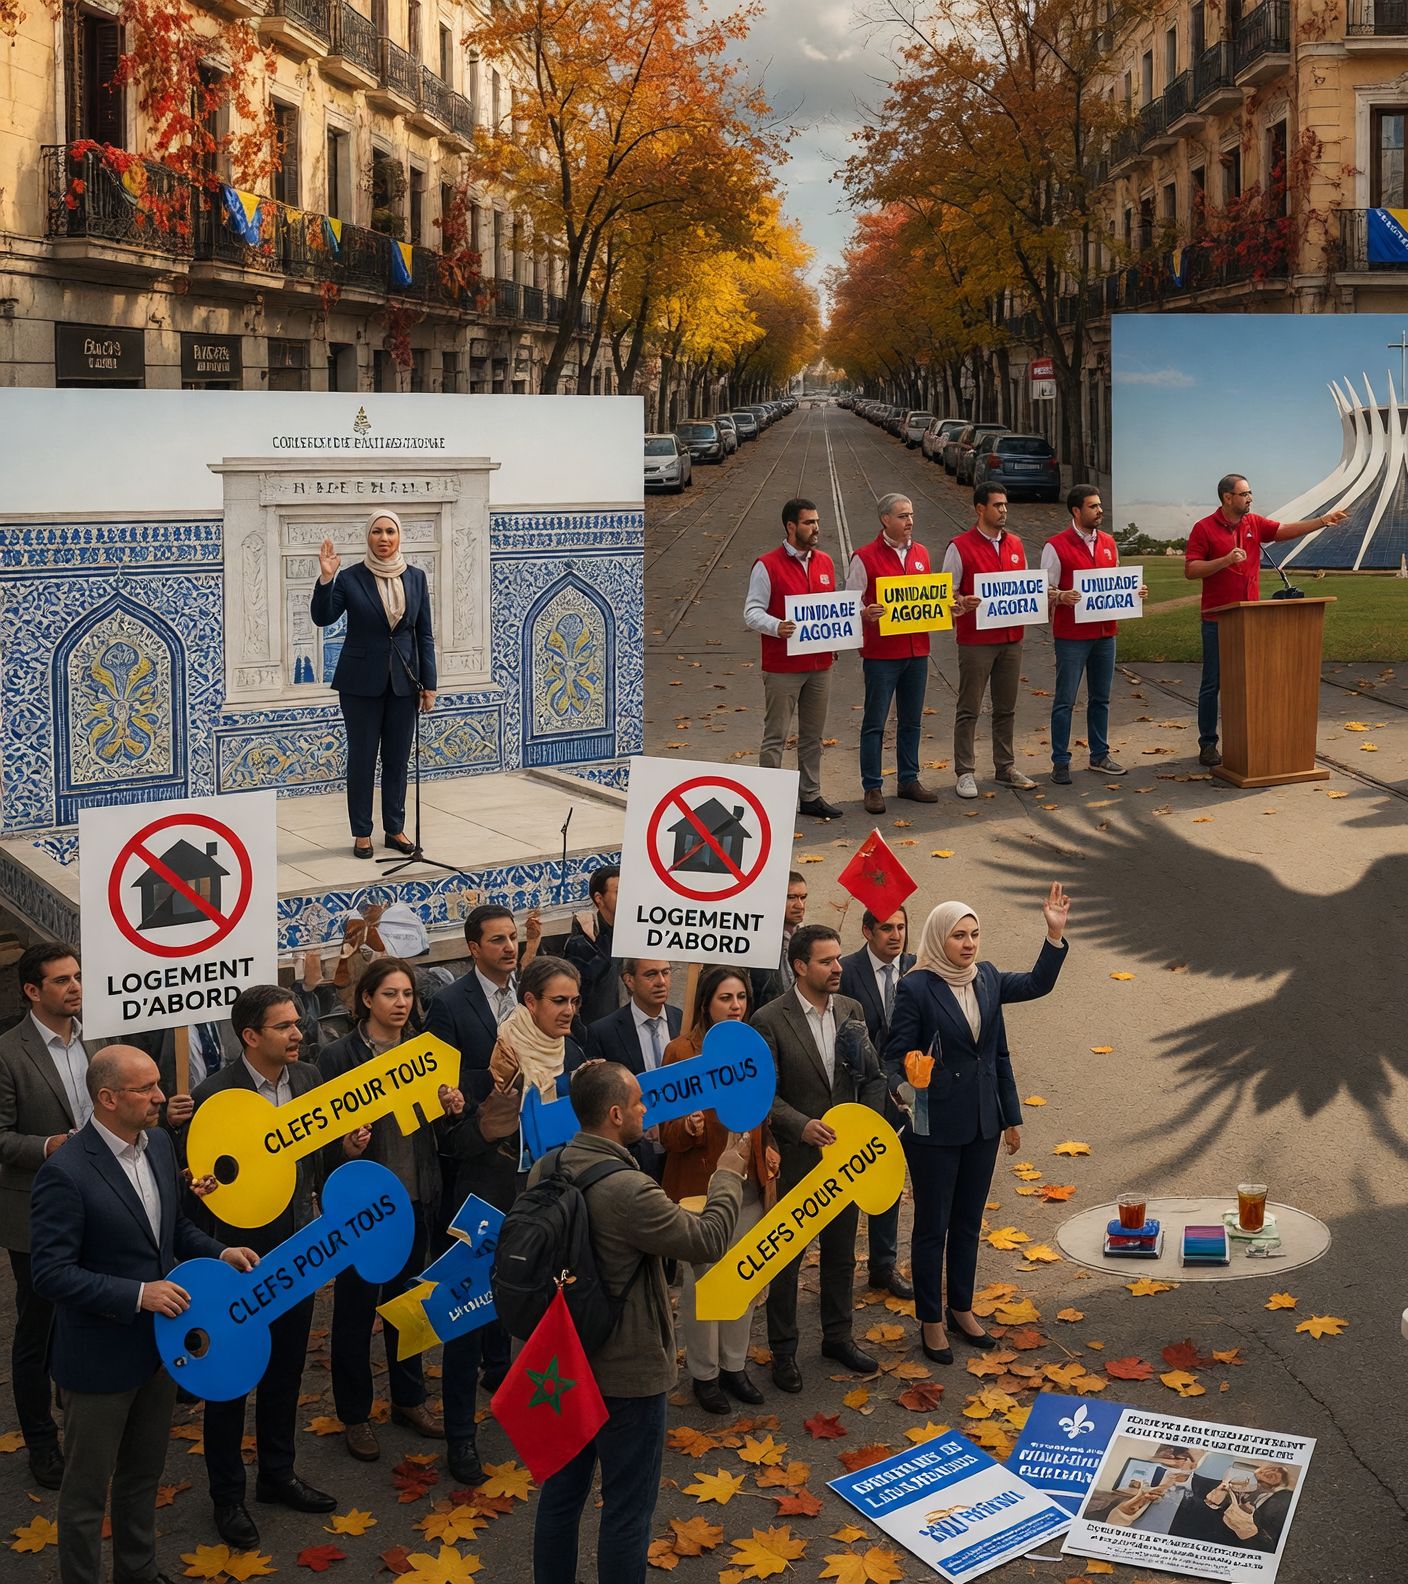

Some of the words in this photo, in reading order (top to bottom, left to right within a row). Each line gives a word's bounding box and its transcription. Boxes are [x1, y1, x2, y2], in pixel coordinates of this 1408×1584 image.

[891, 603, 944, 623] AGORA
[799, 621, 853, 643] AGORA
[636, 905, 765, 932] LOGEMENT
[646, 929, 751, 954] D'ABORD
[107, 957, 254, 996] LOGEMENT
[122, 985, 242, 1021] D'ABORD
[706, 1057, 758, 1090] TOUS
[263, 1107, 329, 1154] CLEFS
[330, 1077, 387, 1121] POUR
[385, 1051, 438, 1090] TOUS
[736, 1222, 795, 1281] CLEFS
[790, 1178, 844, 1229] POUR
[838, 1136, 887, 1183] TOUS
[228, 1267, 294, 1324] CLEFS
[293, 1229, 349, 1278] POUR
[345, 1194, 397, 1238] TOUS
